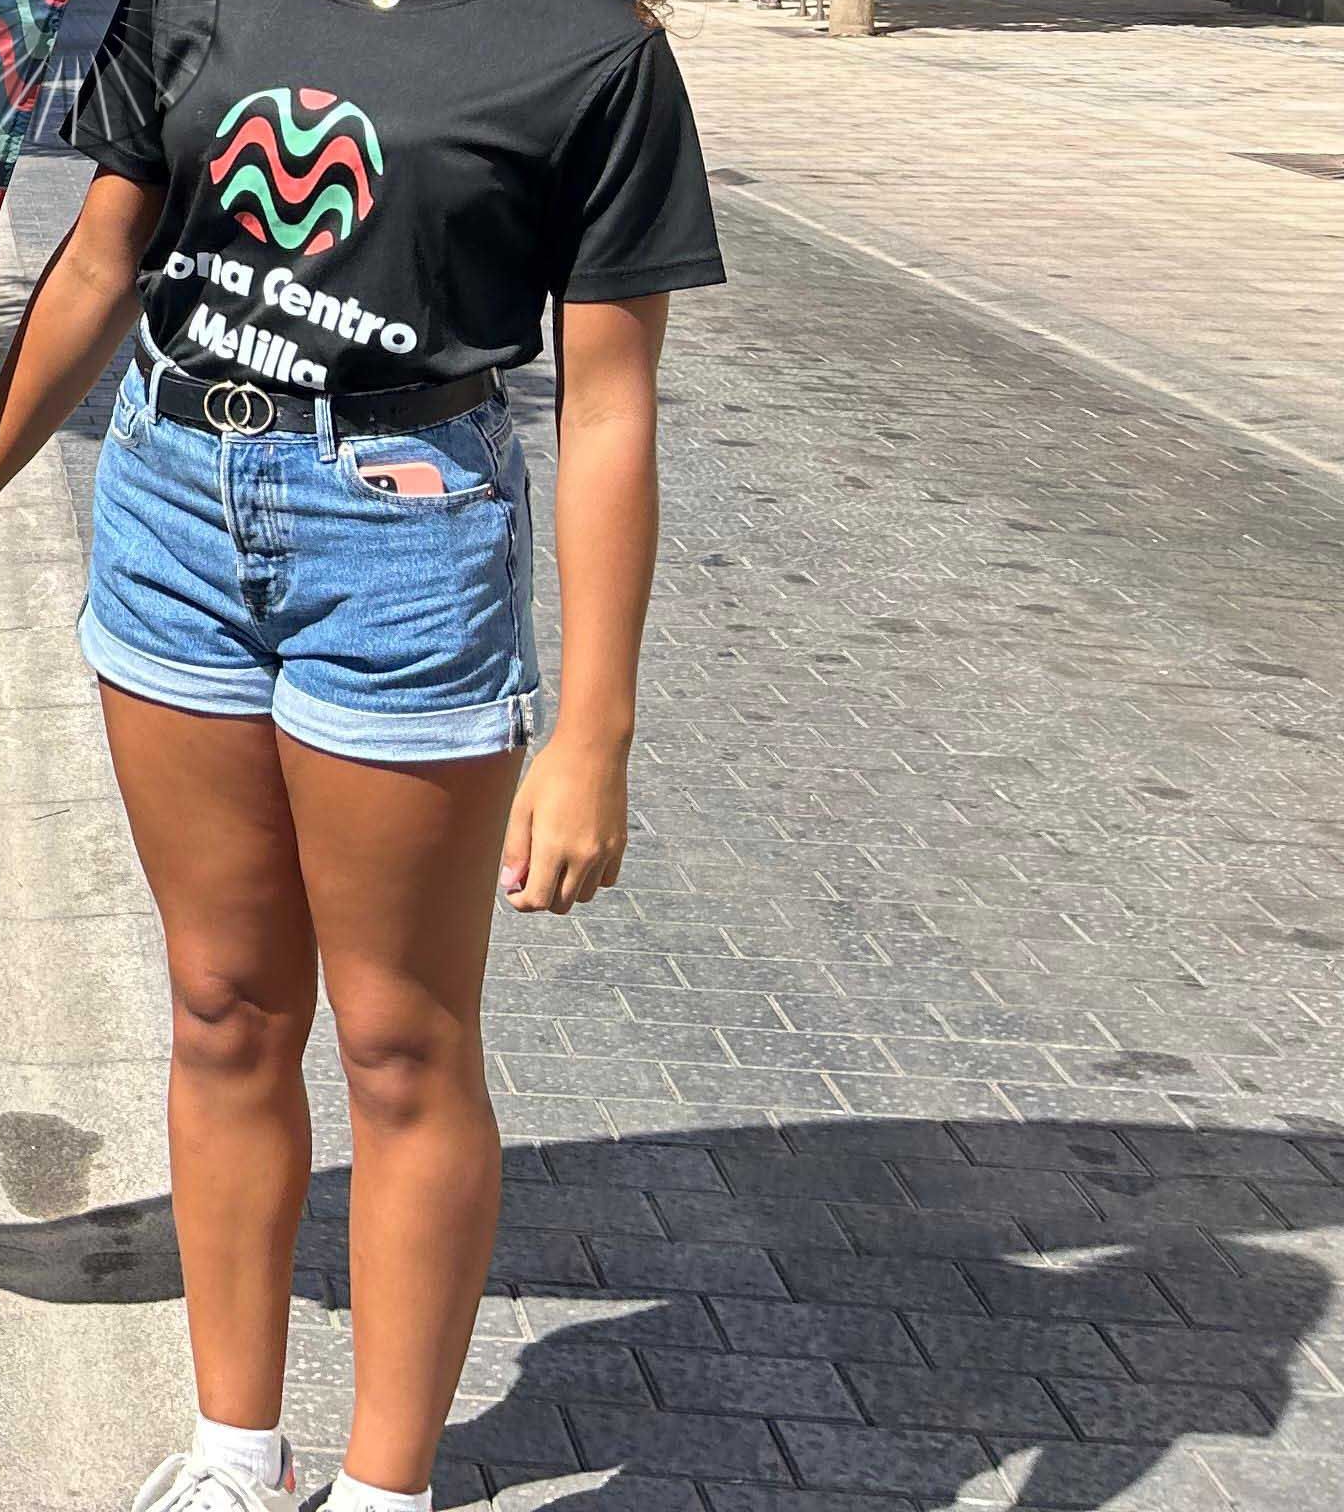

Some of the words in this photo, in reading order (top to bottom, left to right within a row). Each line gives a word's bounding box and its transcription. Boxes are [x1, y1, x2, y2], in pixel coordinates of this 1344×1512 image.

[163, 251, 254, 297] ona
[263, 267, 417, 354] Centro
[188, 303, 328, 390] Melilla
